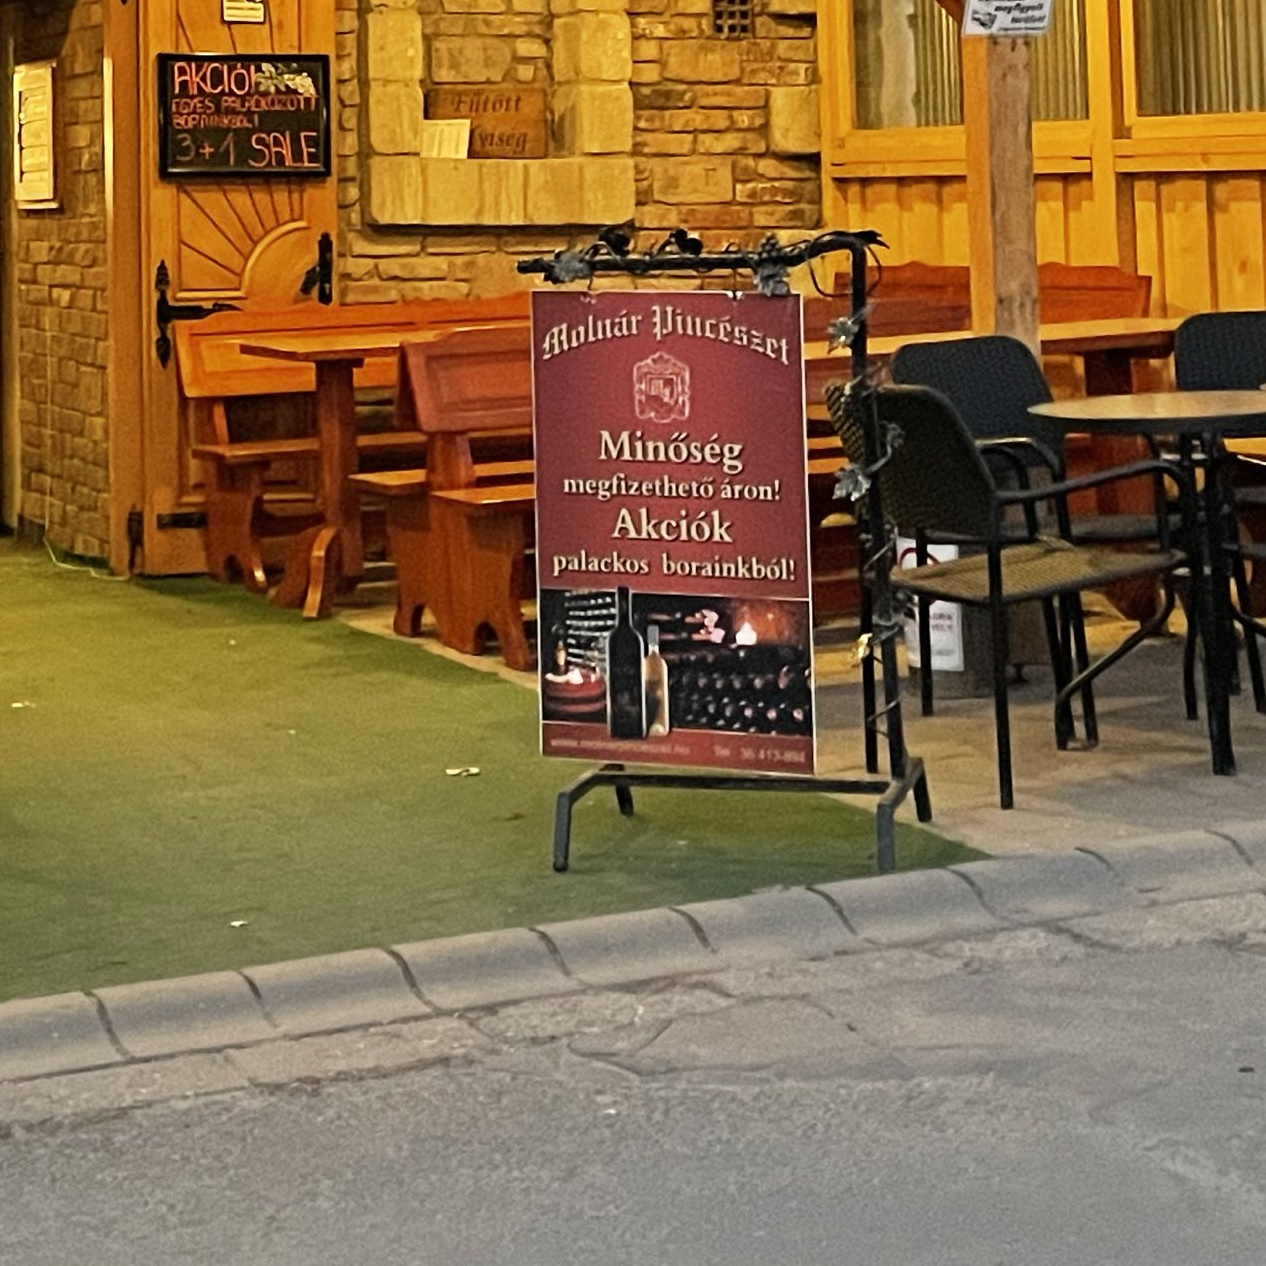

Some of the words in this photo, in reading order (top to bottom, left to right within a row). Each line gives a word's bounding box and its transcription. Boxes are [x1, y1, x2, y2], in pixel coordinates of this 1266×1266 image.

[248, 131, 321, 167] SALE
[542, 309, 643, 360] Molnár
[651, 305, 790, 365] Pincészet
[598, 430, 744, 474] Minőség
[563, 473, 715, 501] megfizethető
[720, 477, 782, 501] áron!
[610, 507, 734, 543] Akciók
[552, 549, 650, 577] palackos
[661, 553, 796, 581] borainkból!
